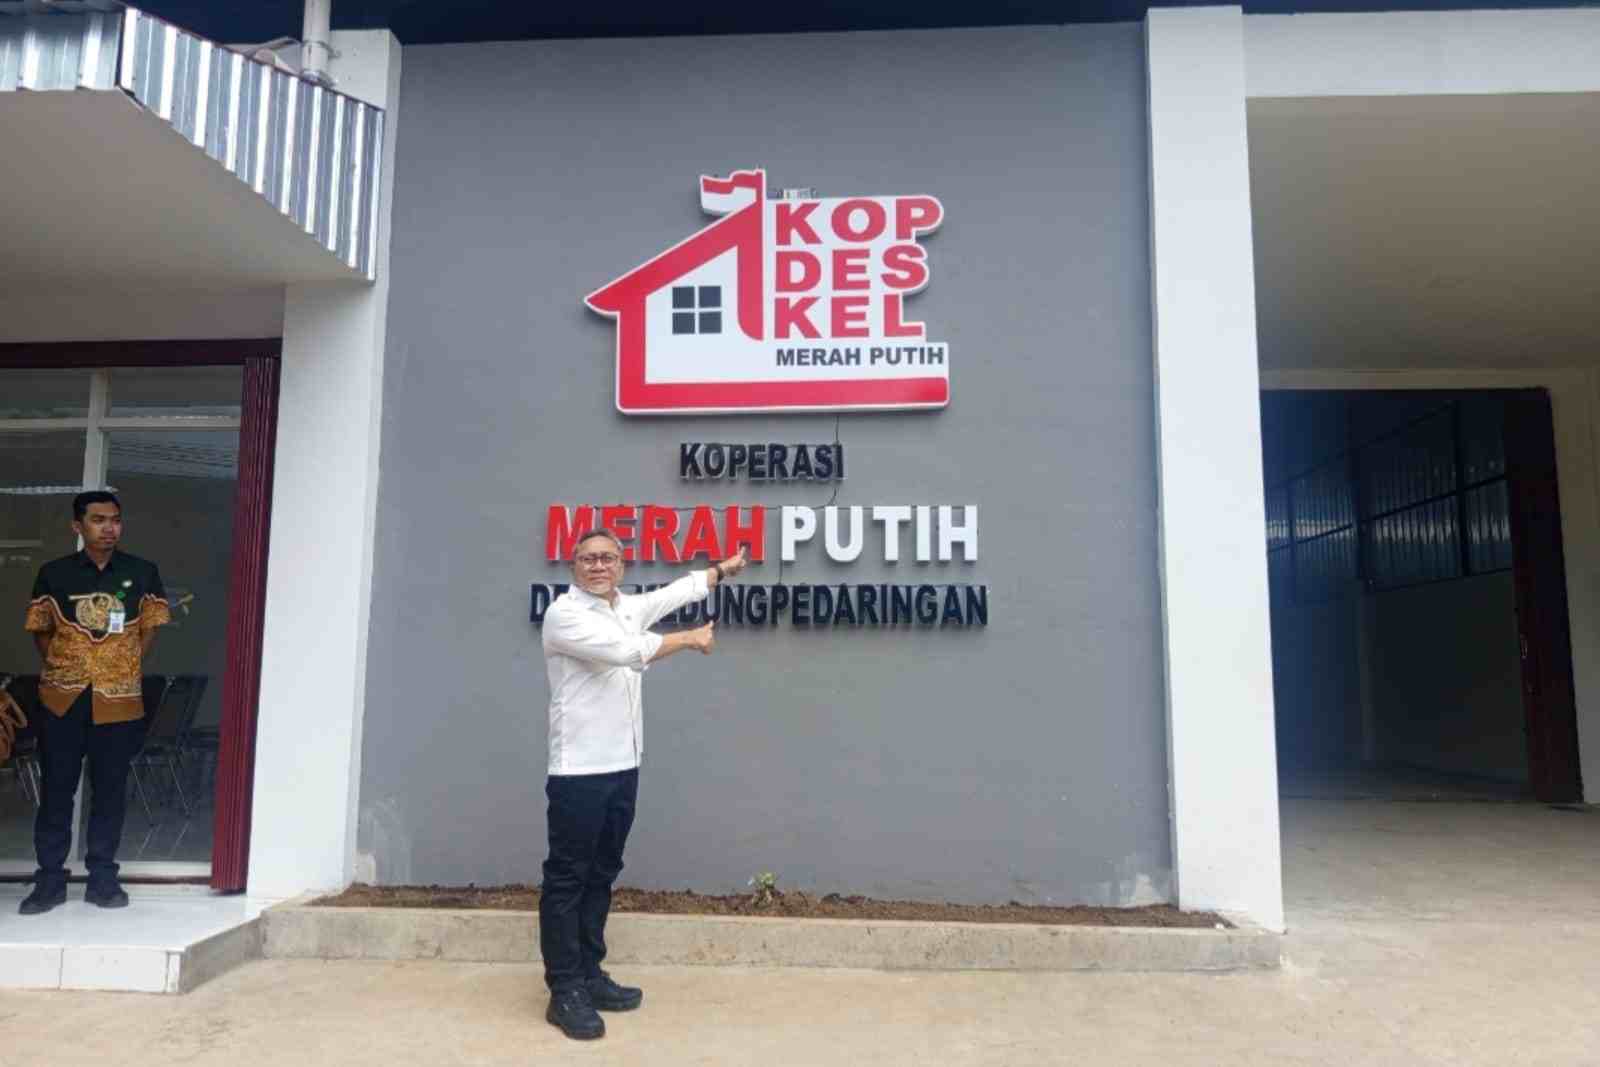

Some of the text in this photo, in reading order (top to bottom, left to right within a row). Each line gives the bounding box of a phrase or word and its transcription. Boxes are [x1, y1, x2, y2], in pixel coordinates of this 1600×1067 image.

[775, 197, 941, 246] KOP
[775, 244, 926, 293] DES
[774, 294, 923, 339] KEL
[776, 347, 944, 366] MERAH PUTIH
[679, 442, 845, 480] KOPERASI
[545, 504, 979, 563] MERAH PUTIH
